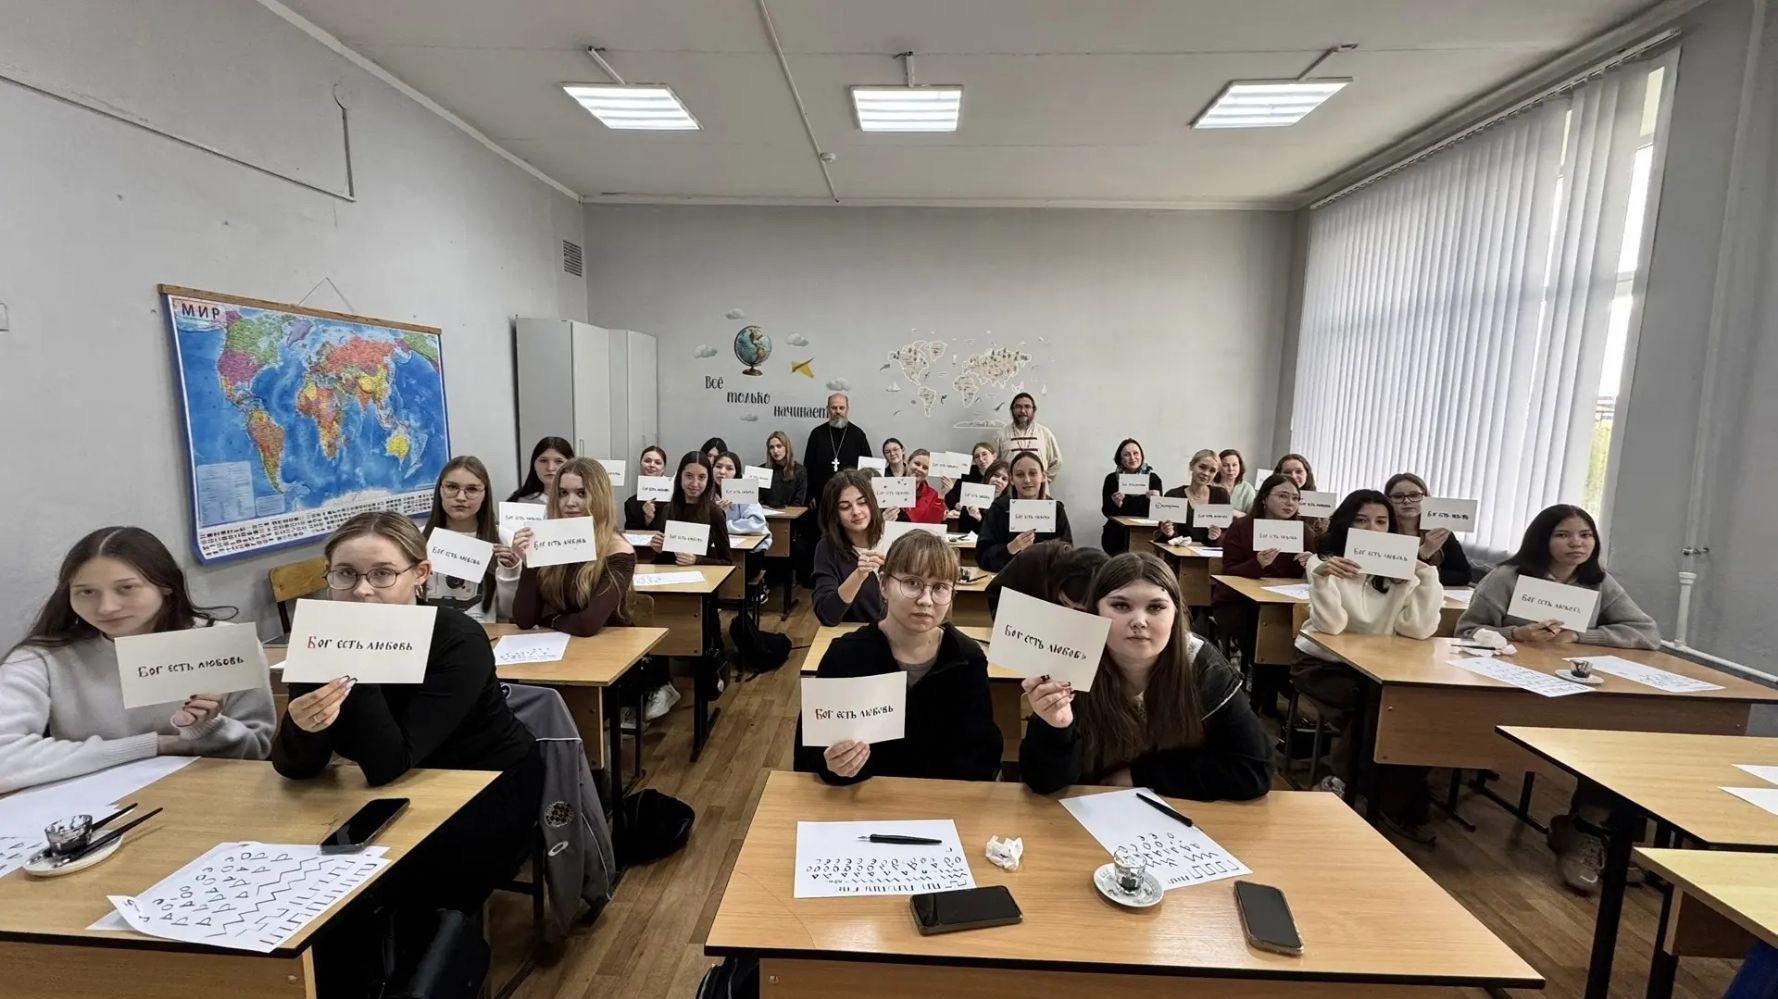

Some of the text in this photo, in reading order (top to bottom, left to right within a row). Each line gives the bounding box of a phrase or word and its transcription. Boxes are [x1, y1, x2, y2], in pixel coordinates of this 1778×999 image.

[182, 303, 220, 319] МИР
[705, 375, 724, 389] Всё
[726, 391, 771, 404] только
[773, 405, 829, 419] начинает
[307, 636, 413, 651] Бог есть любовь
[1004, 624, 1023, 640] Бог
[1024, 634, 1045, 649] есть
[138, 656, 244, 678] Бог есть любовь
[815, 708, 834, 720] Бог
[836, 708, 857, 719] есть
